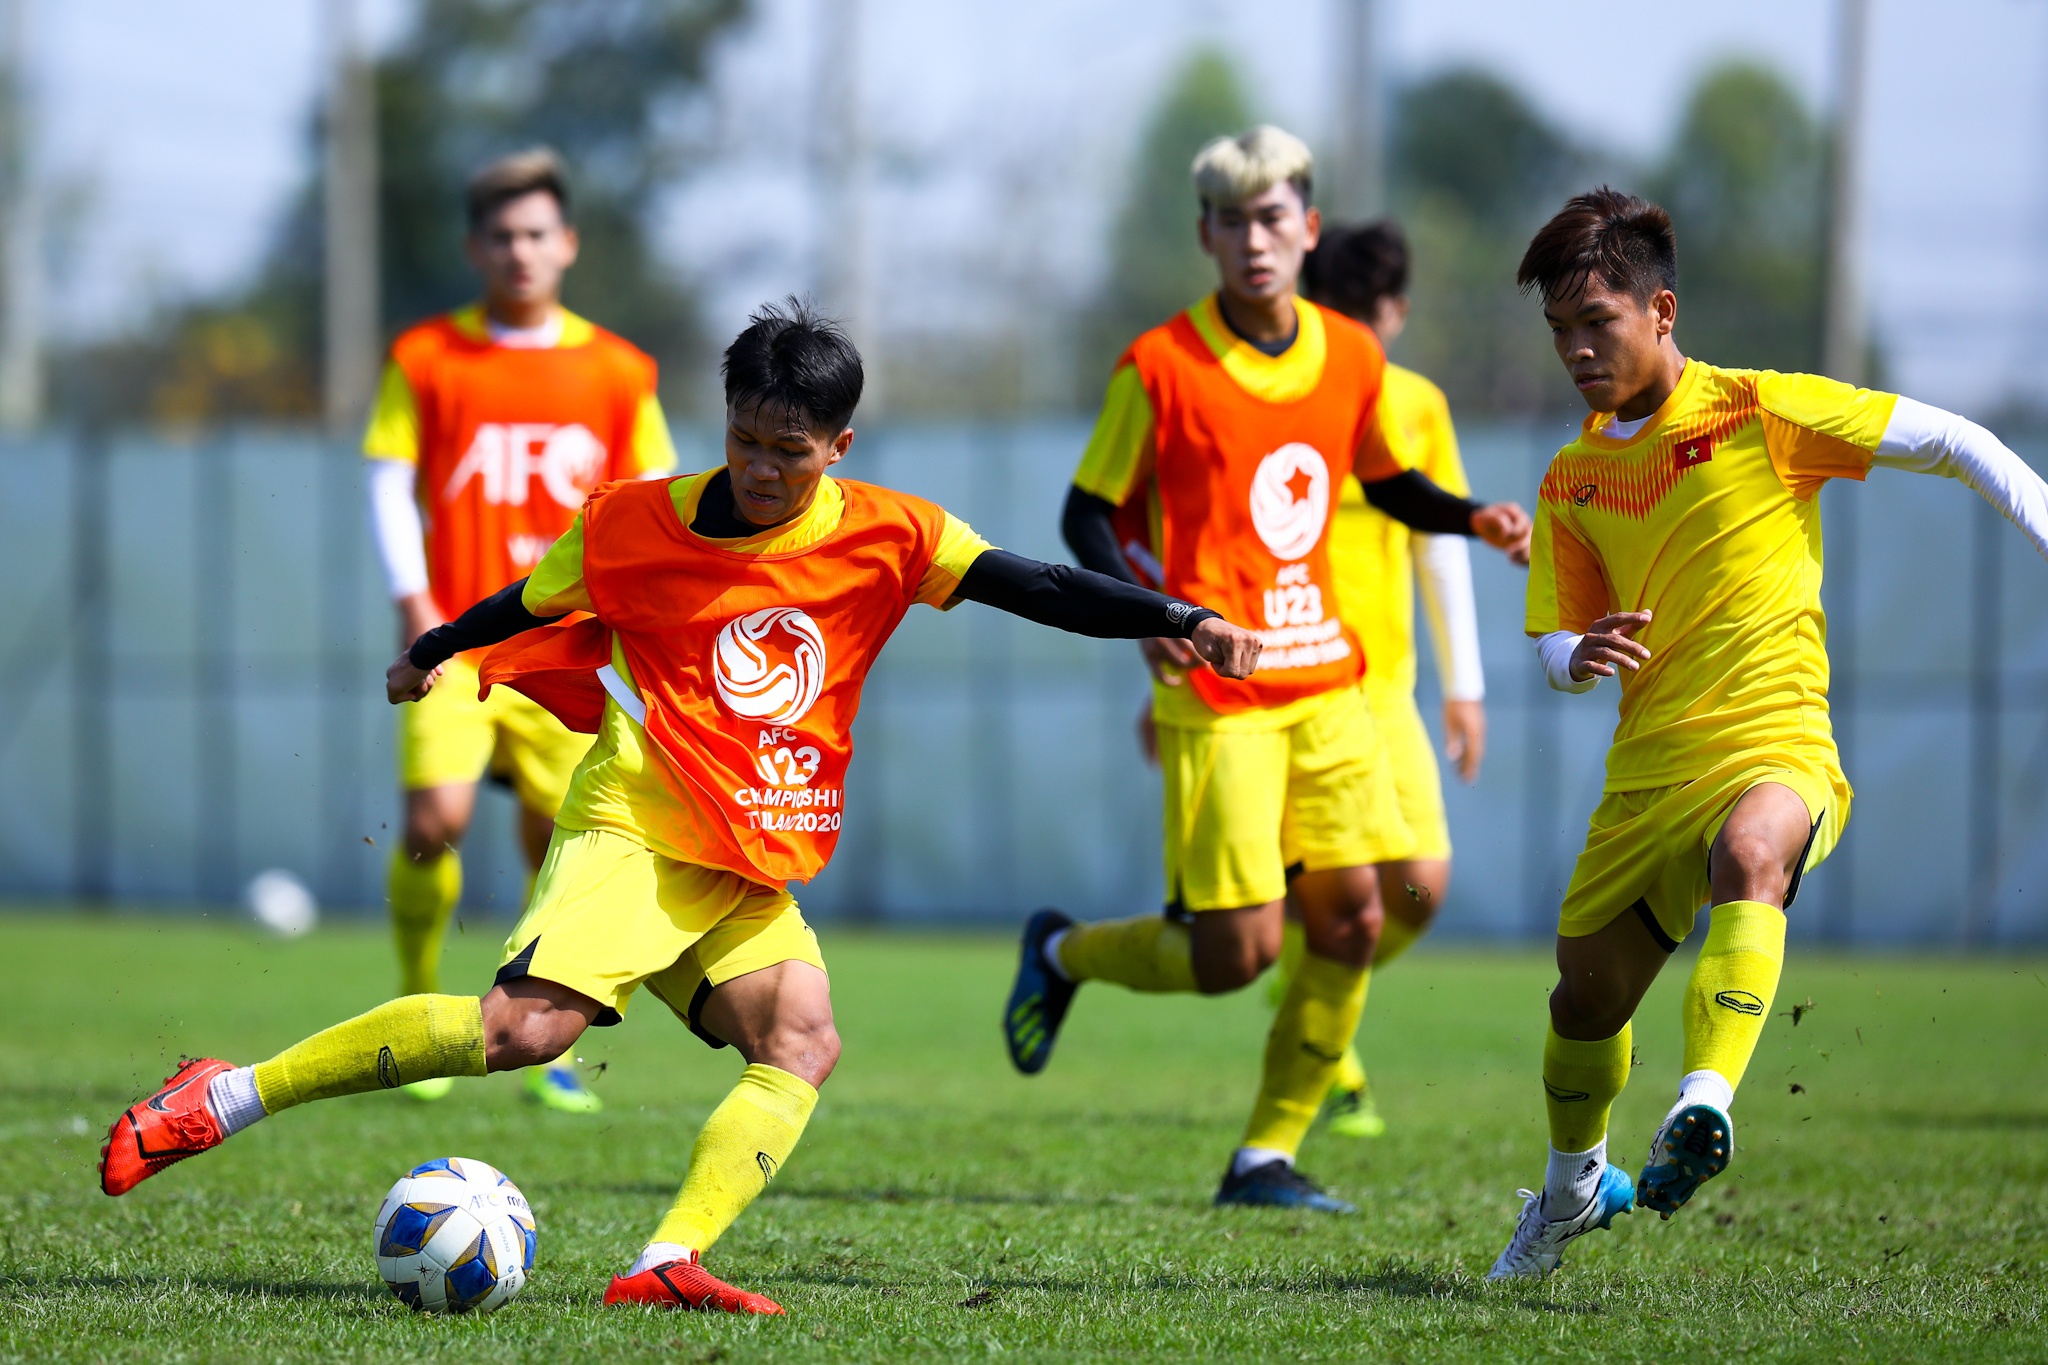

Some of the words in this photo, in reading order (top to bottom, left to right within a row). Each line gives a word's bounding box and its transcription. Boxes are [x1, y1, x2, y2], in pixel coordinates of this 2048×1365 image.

[1262, 583, 1324, 628] U23
[758, 727, 797, 749] AFC
[756, 746, 821, 786] U23
[795, 812, 841, 832] 2020
